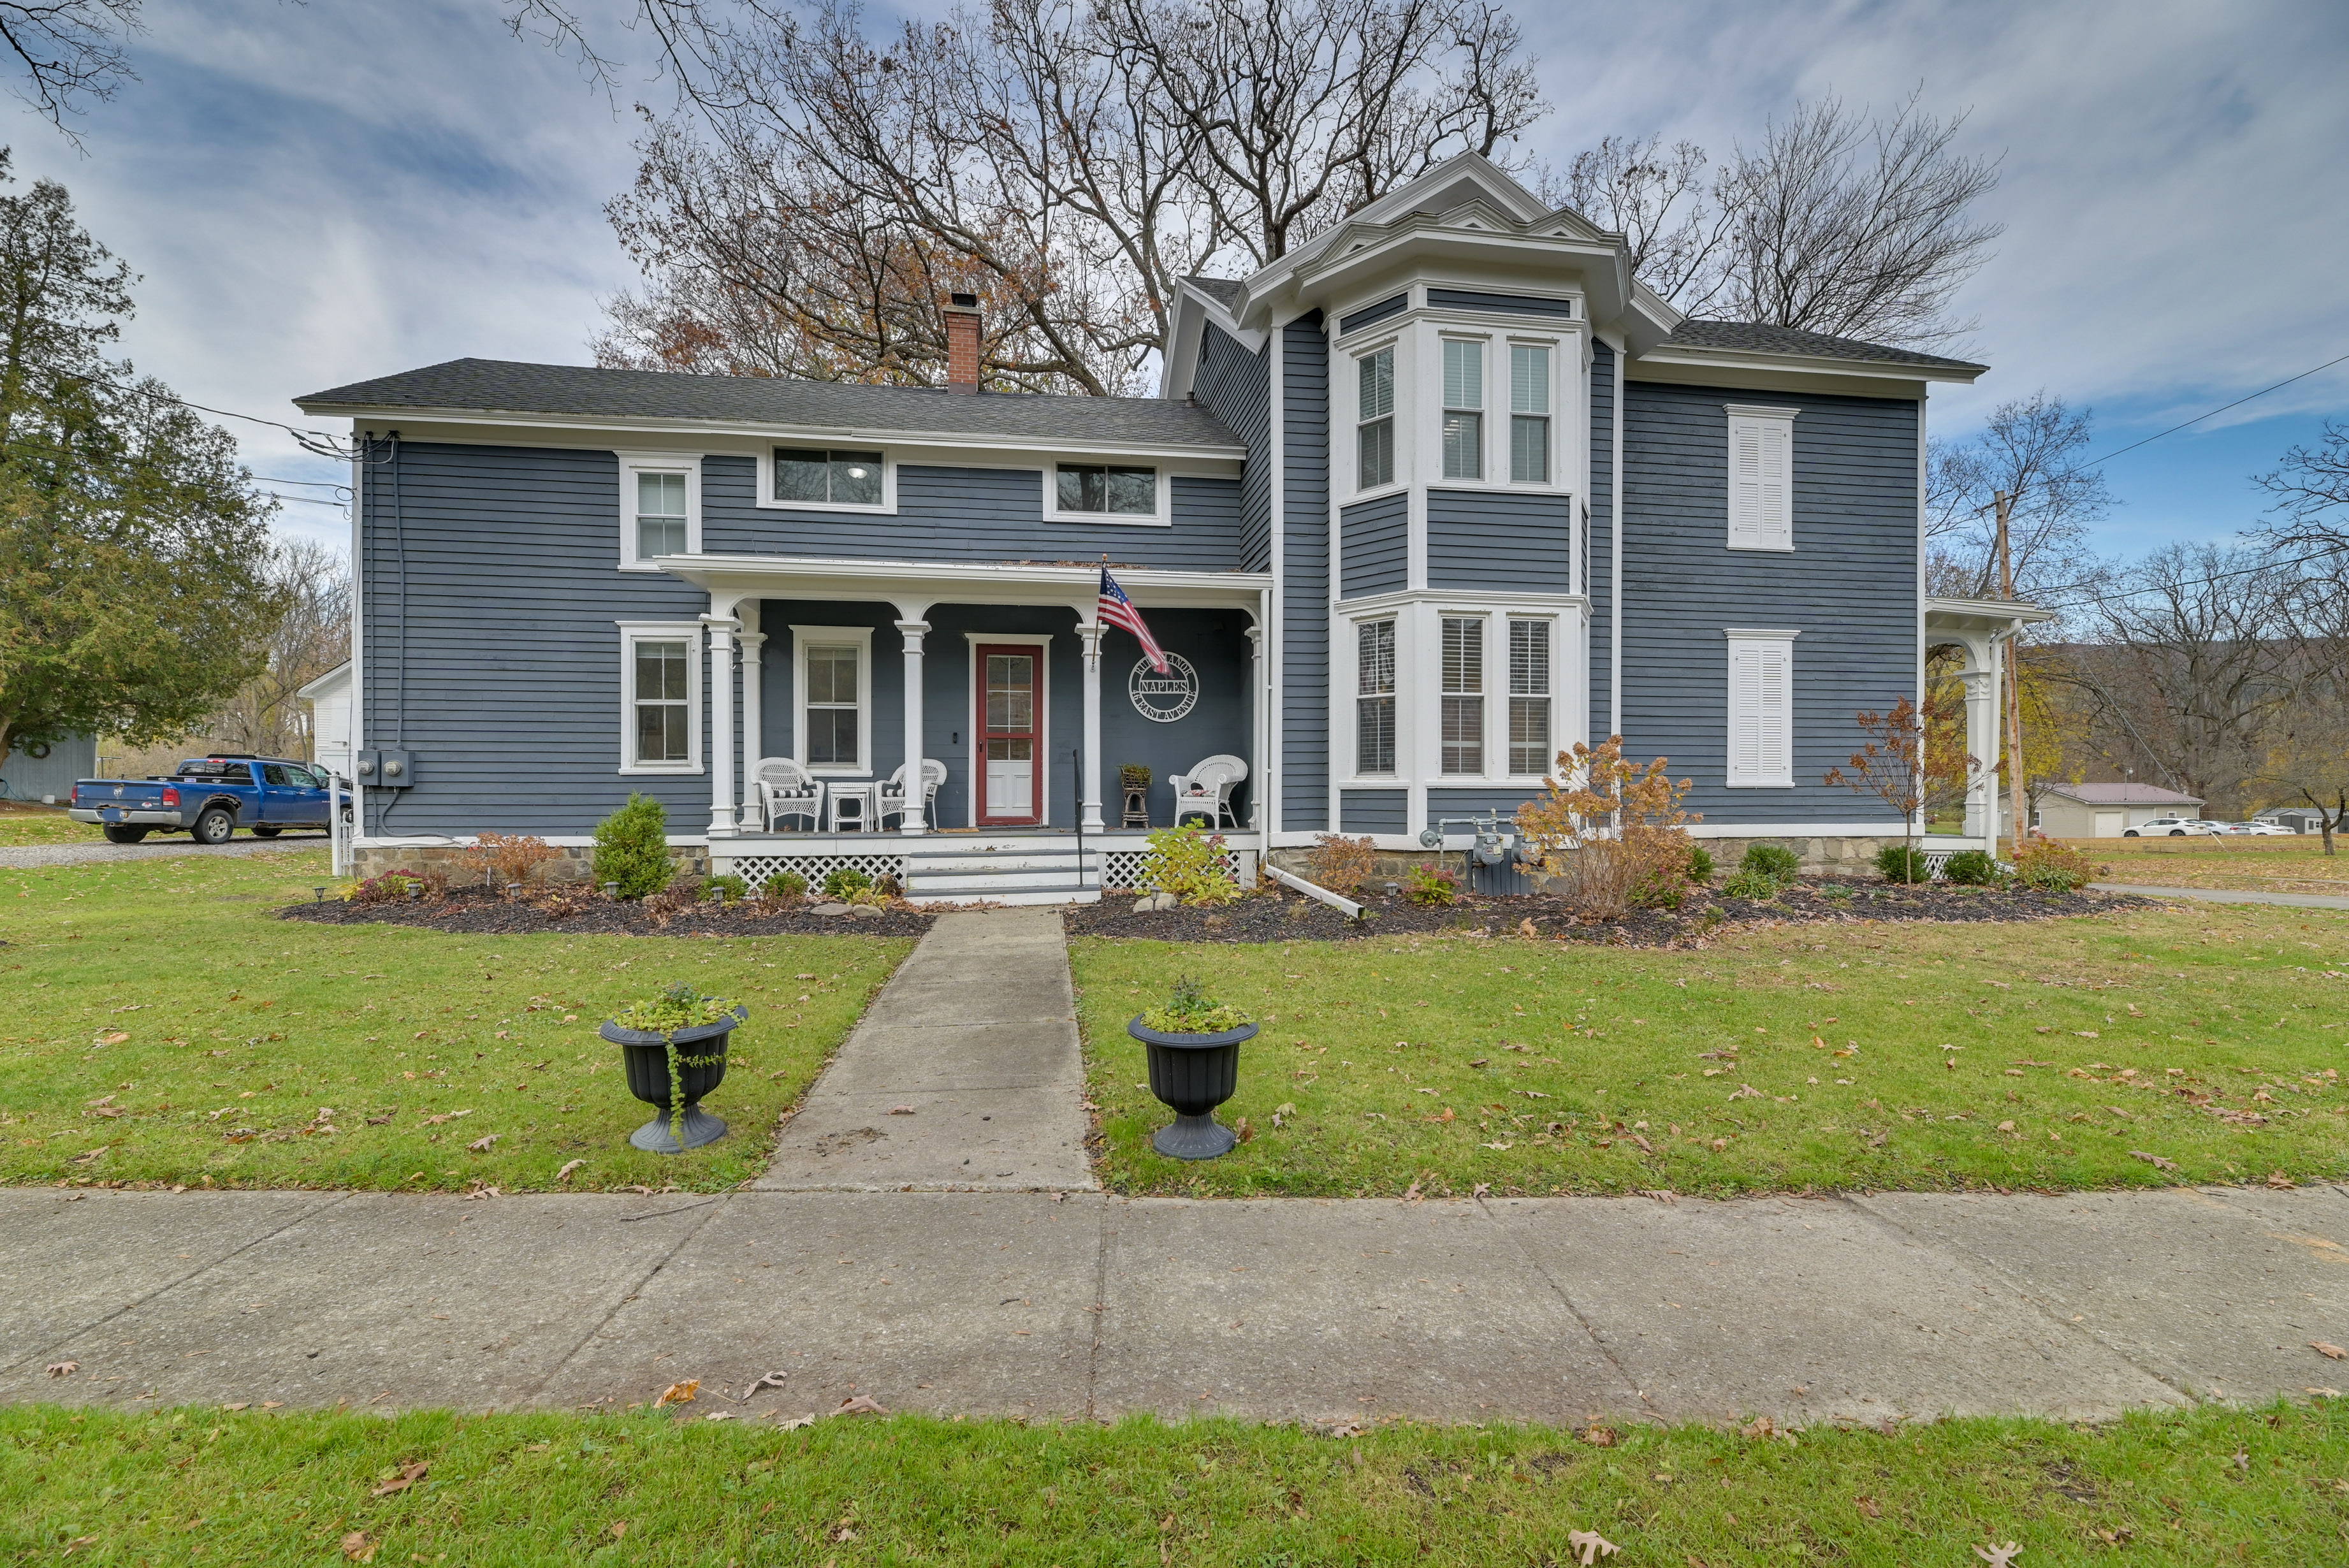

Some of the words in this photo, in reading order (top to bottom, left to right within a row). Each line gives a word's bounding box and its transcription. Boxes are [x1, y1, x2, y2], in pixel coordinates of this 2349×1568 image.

[1141, 681, 1188, 693] NAPLES
[1131, 690, 1142, 701] 46
[1138, 701, 1161, 719] EAST
[1164, 690, 1196, 720] AVENUE
